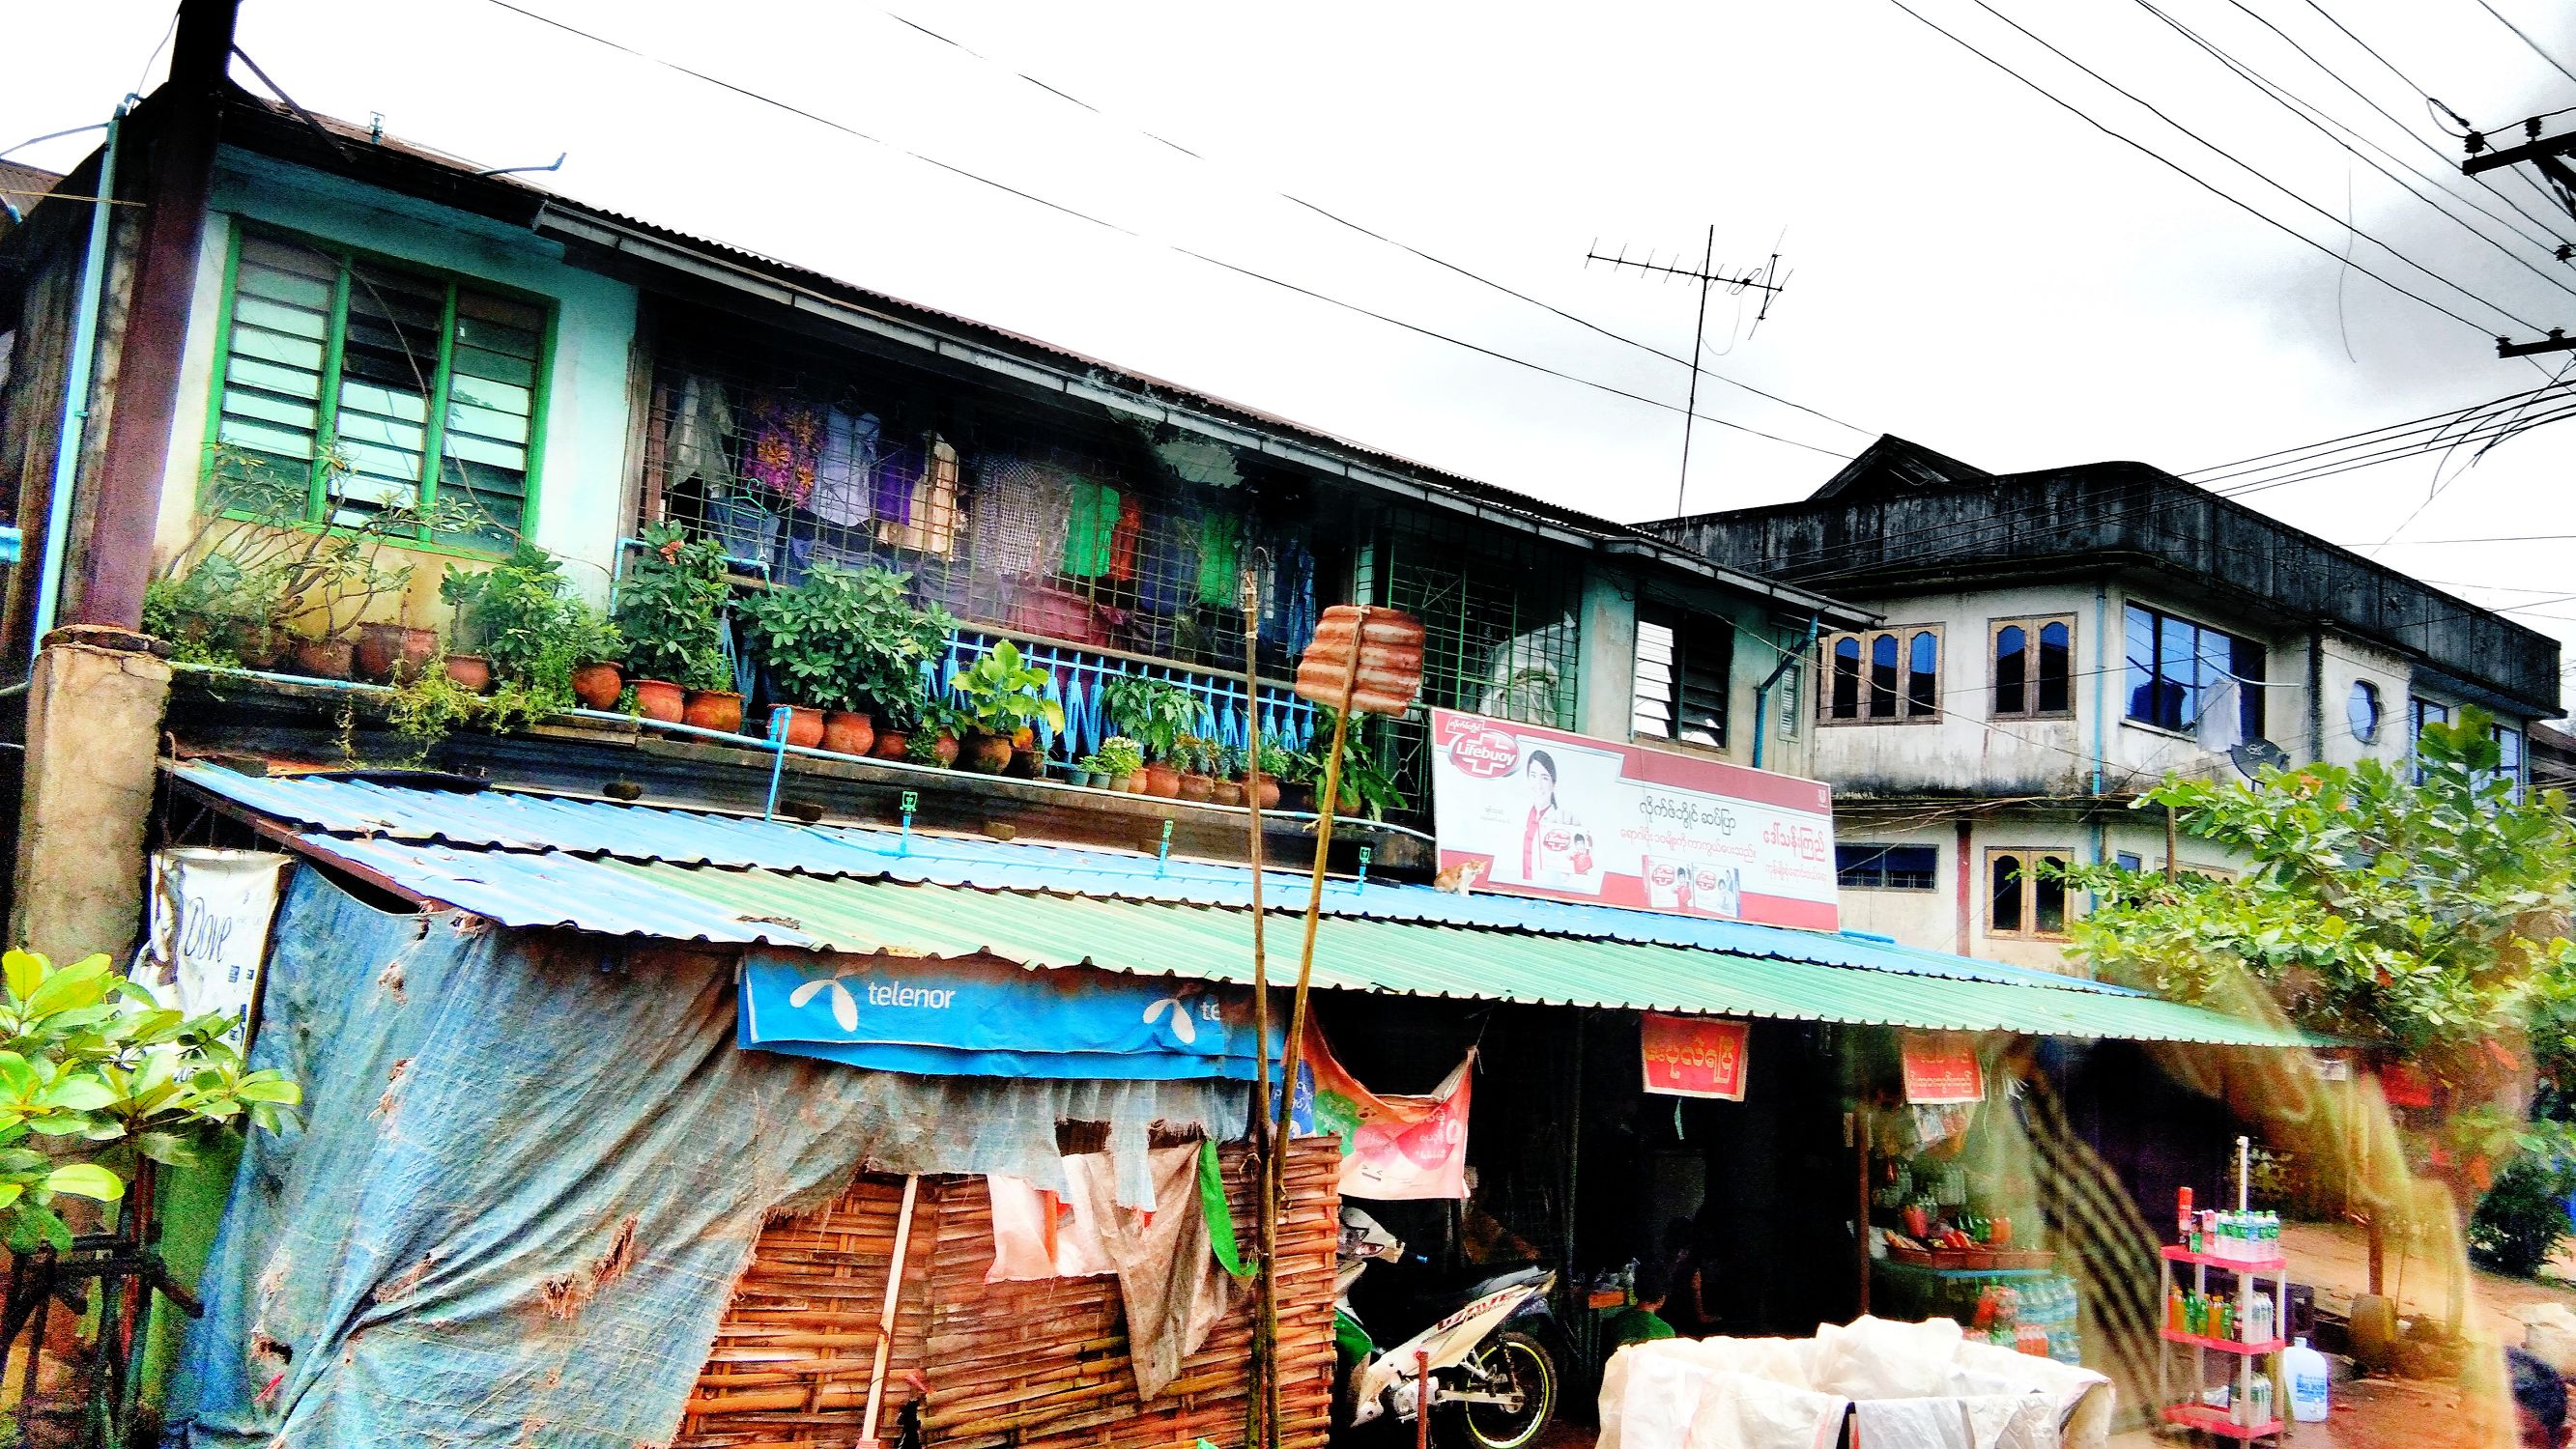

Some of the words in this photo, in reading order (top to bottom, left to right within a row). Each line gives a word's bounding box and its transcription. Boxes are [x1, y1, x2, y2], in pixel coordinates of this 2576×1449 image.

[1456, 741, 1516, 766] Lifebuoy
[185, 896, 232, 963] Dove
[868, 980, 957, 1009] telenor
